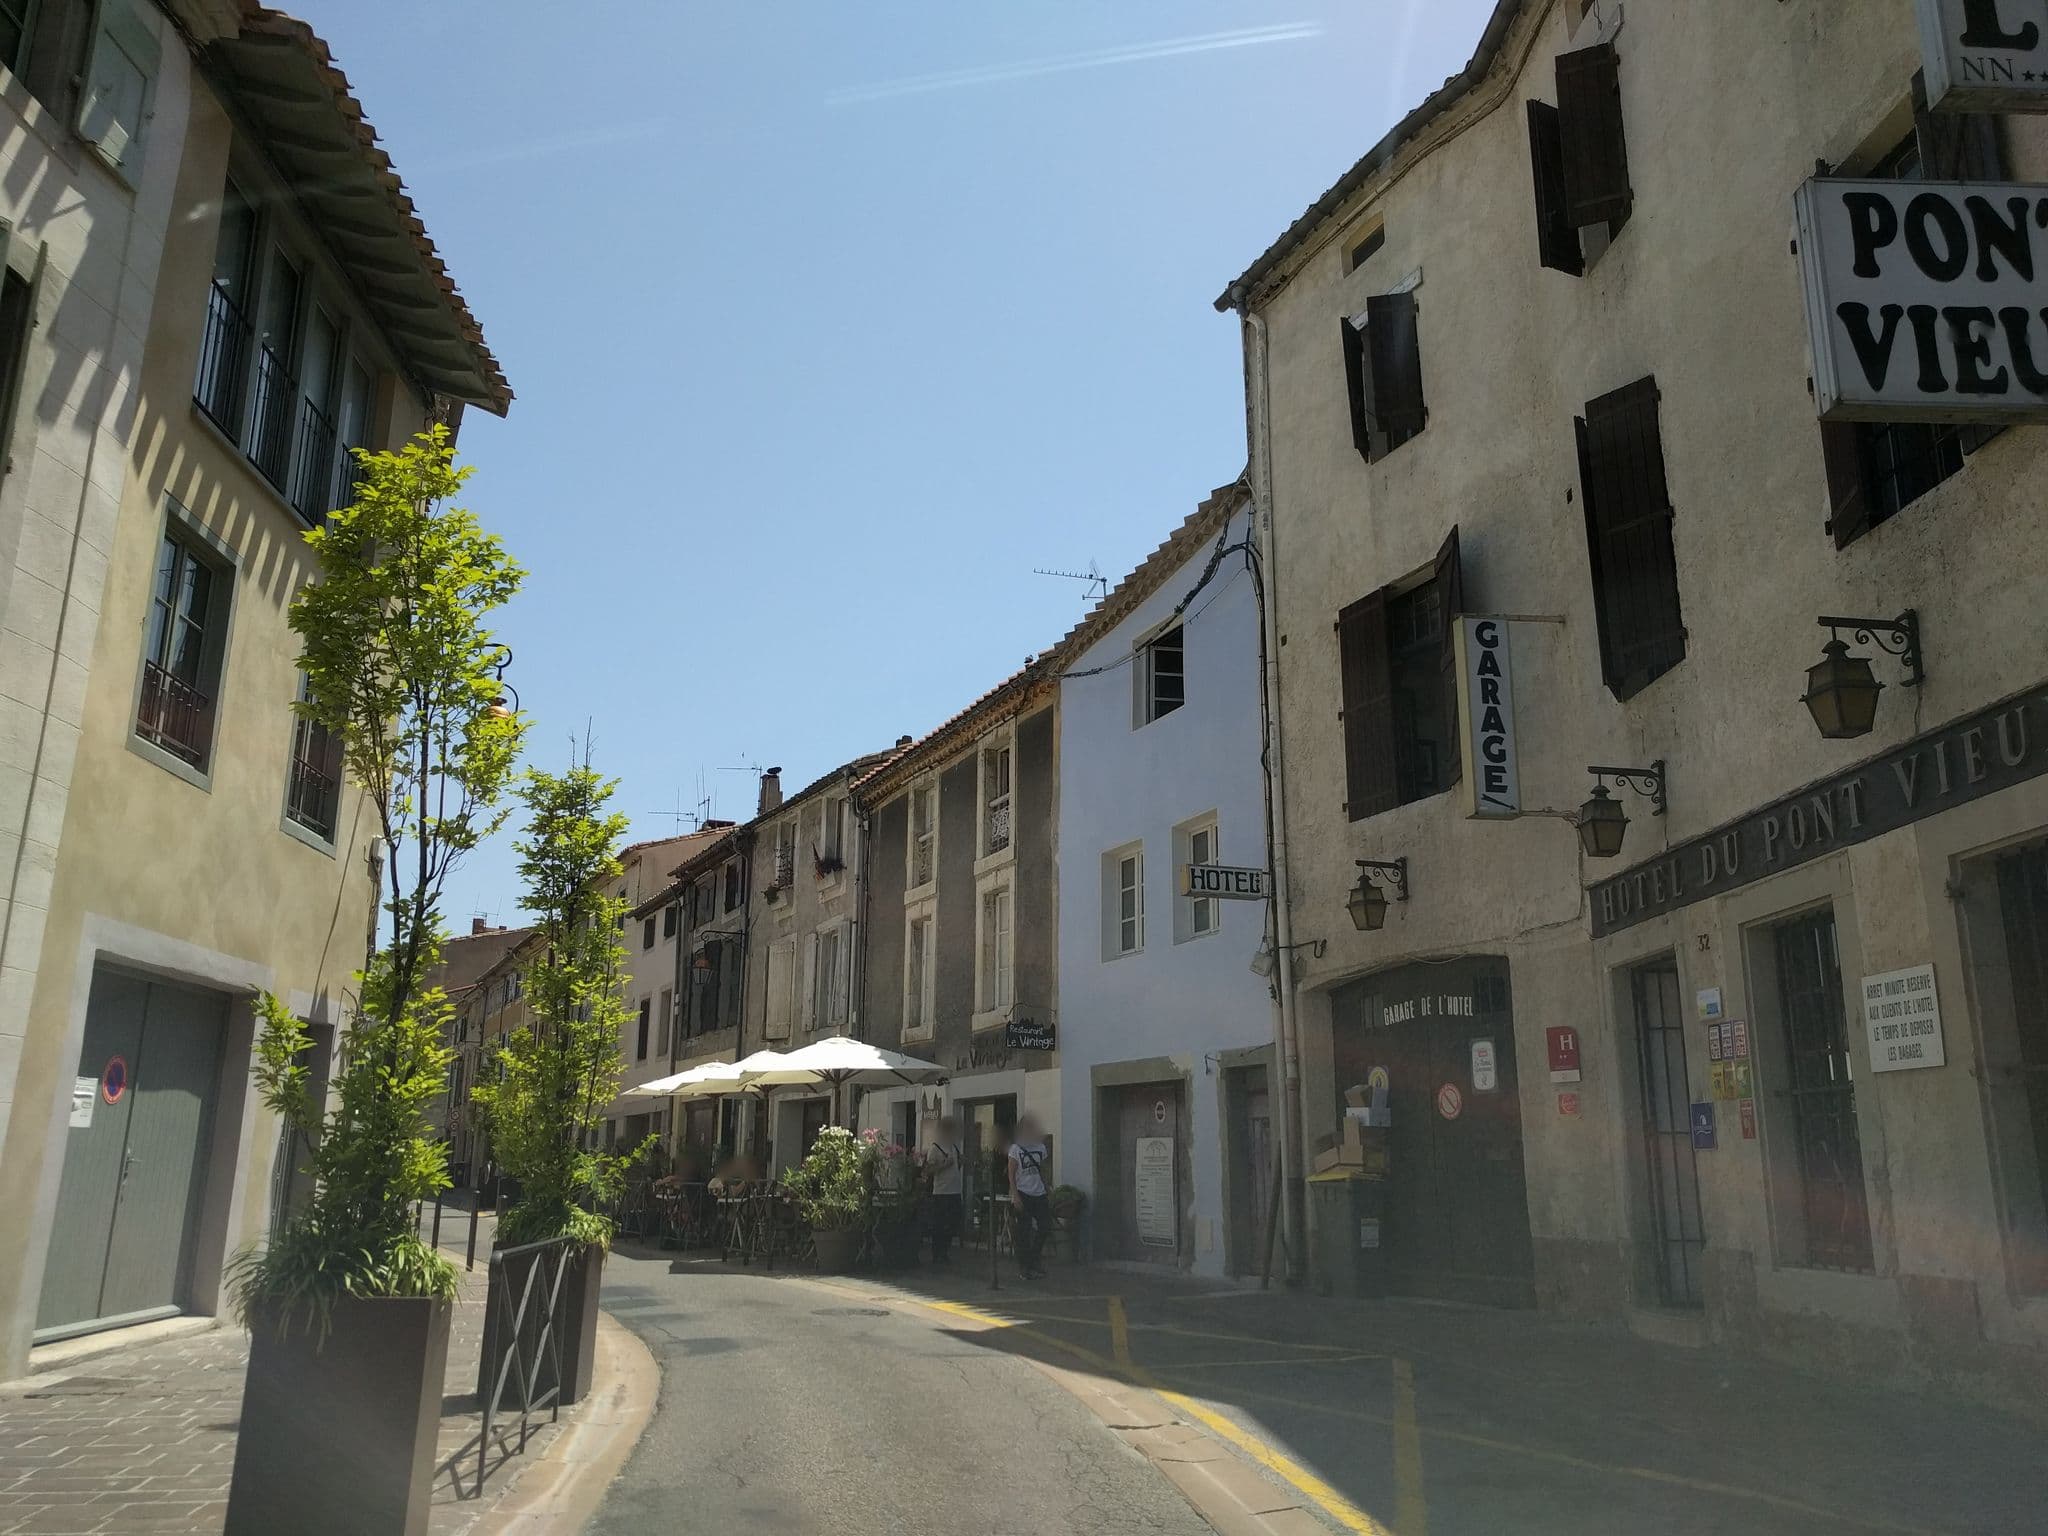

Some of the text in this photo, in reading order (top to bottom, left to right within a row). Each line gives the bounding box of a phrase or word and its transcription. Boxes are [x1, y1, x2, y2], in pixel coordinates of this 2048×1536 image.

[1960, 56, 2014, 82] NN
[1842, 192, 2048, 282] PON
[1475, 621, 1508, 794] GARAGE
[1601, 696, 2048, 925] HOTEL DU PONT VIEU
[1190, 868, 1260, 894] HOTEL
[1697, 934, 1711, 951] 32
[1866, 983, 1883, 1000] ARRET
[1884, 979, 1905, 997] MINUTE
[1383, 994, 1474, 1026] GARAGE DE L'HOTEL
[1869, 996, 1934, 1020] AUX CLIENTS DE L'HOTEL
[1008, 1024, 1043, 1036] Restaurant
[1873, 1019, 1935, 1041] LE TEMPS DE DEPOSER
[1006, 1035, 1055, 1050] Le Vintage
[1559, 1034, 1574, 1051] H
[1888, 1045, 1897, 1062] LES
